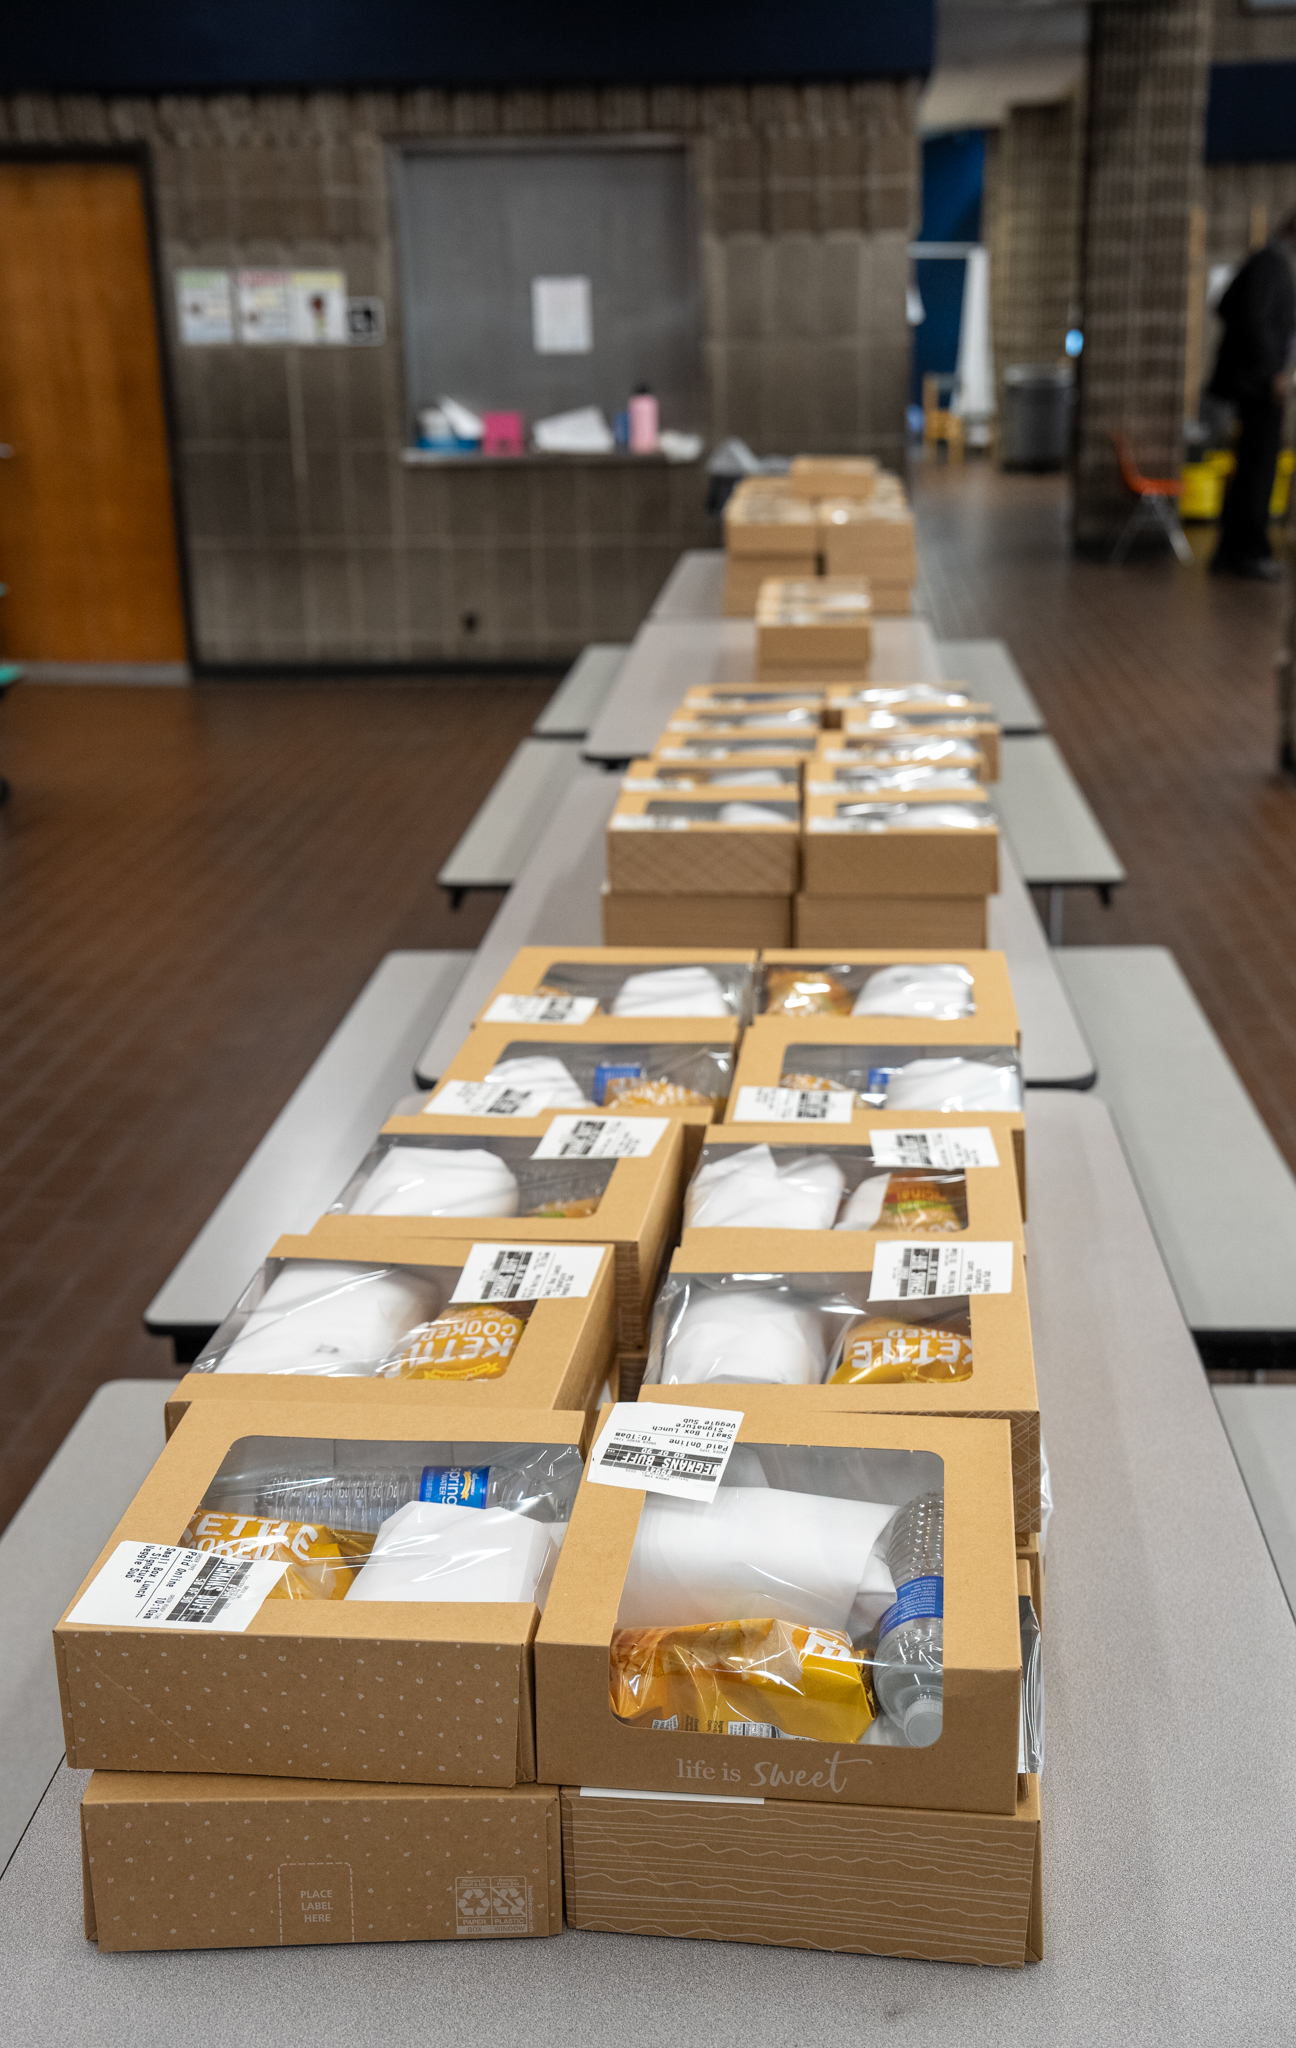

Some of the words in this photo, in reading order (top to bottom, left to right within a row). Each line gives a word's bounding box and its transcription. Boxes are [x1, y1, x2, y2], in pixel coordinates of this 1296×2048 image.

[888, 1328, 962, 1338] OKED
[652, 1426, 678, 1434] Lunch
[676, 1423, 724, 1433] Signature
[704, 1420, 736, 1429] Veggie
[614, 1432, 652, 1442] 10:10am
[668, 1438, 702, 1448] Online
[706, 1443, 729, 1451] Paid
[620, 1452, 655, 1466] BUFF
[439, 1473, 448, 1495] WATER
[442, 1467, 463, 1505] spring
[134, 1545, 156, 1565] Veggie
[188, 1537, 275, 1560] OKED
[158, 1548, 177, 1565] Small
[181, 1551, 198, 1567] Paid
[125, 1567, 139, 1579] Sub
[133, 1552, 159, 1584] Signature
[149, 1567, 164, 1578] Box
[166, 1568, 187, 1588] Online
[135, 1580, 155, 1598] Lunch
[143, 1597, 167, 1620] 10:10am
[676, 1758, 716, 1780] life
[721, 1762, 742, 1782] is
[749, 1750, 873, 1793] sweet
[300, 1889, 333, 1899] PLACE
[301, 1901, 334, 1911] LABEL
[304, 1913, 331, 1923] HERE
